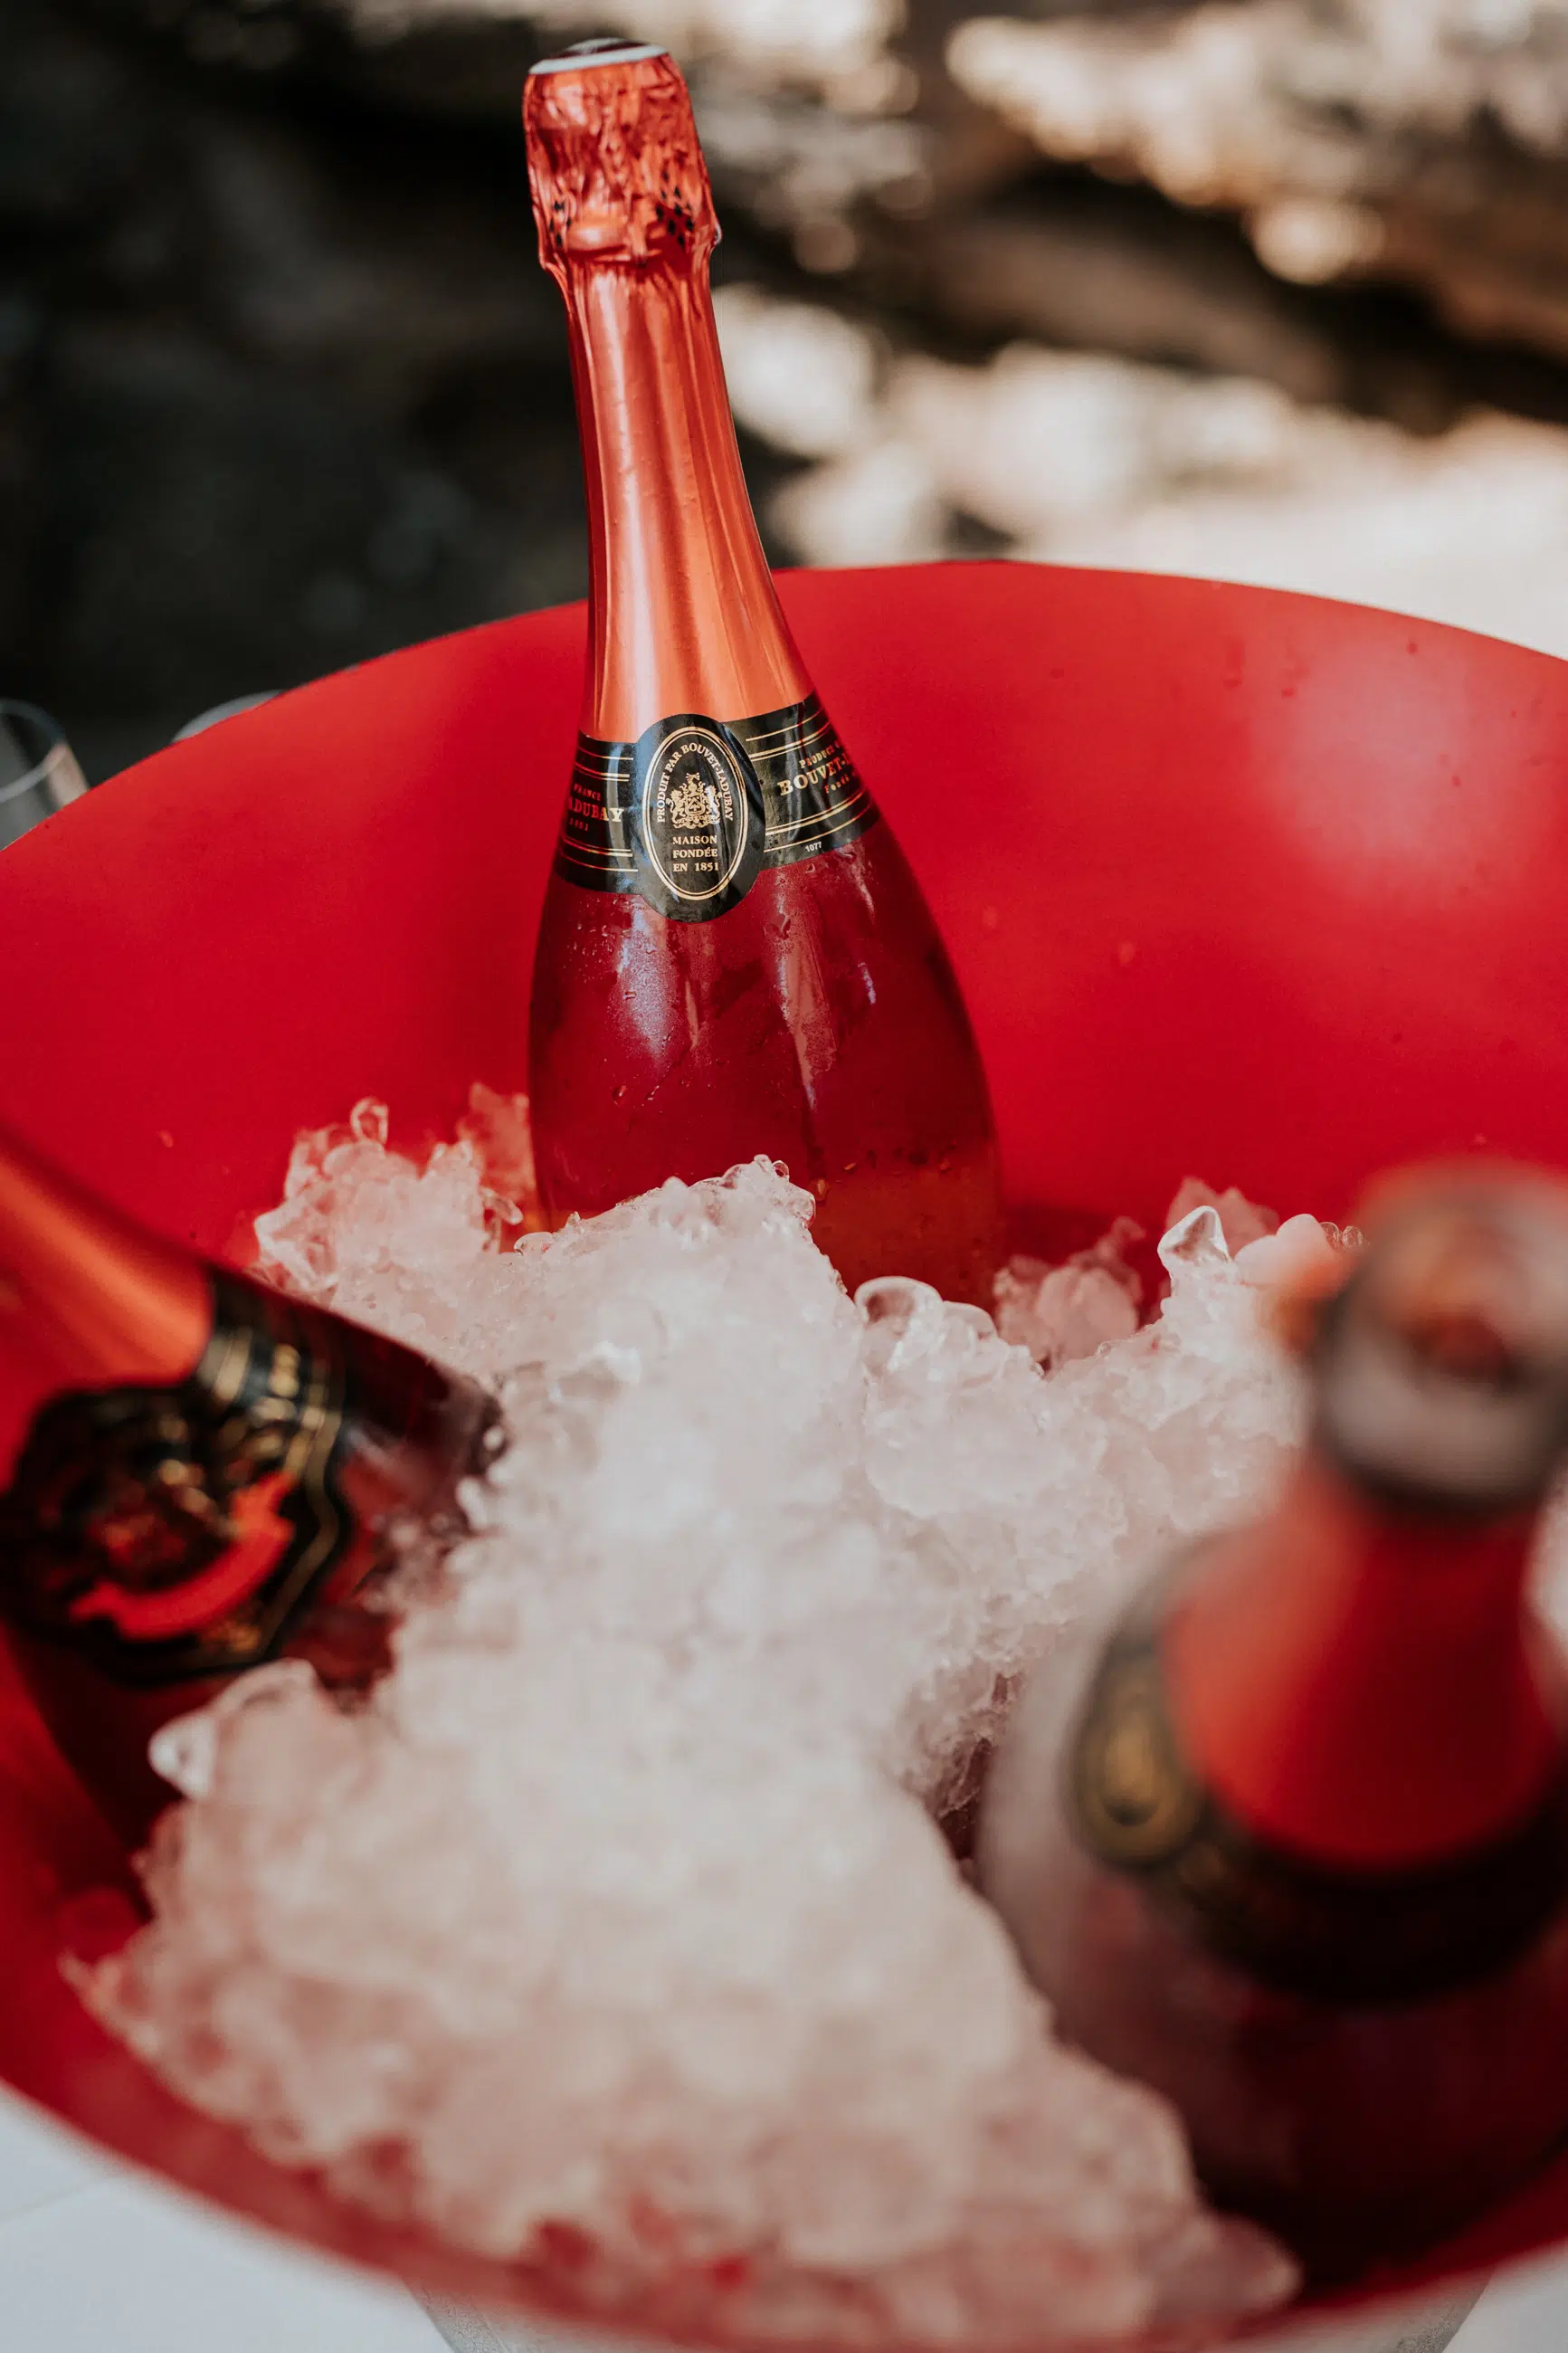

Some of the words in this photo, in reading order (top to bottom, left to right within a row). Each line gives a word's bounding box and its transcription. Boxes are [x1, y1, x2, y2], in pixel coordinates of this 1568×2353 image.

[657, 771, 670, 824] PRODUIT
[665, 751, 682, 771] PAR
[680, 742, 734, 822] BOUVET-LADUBAY
[672, 834, 717, 845] MAISON
[672, 846, 718, 858] FONDÉE
[804, 841, 823, 853] 1077
[672, 862, 689, 872] EN
[694, 862, 719, 872] 1851
